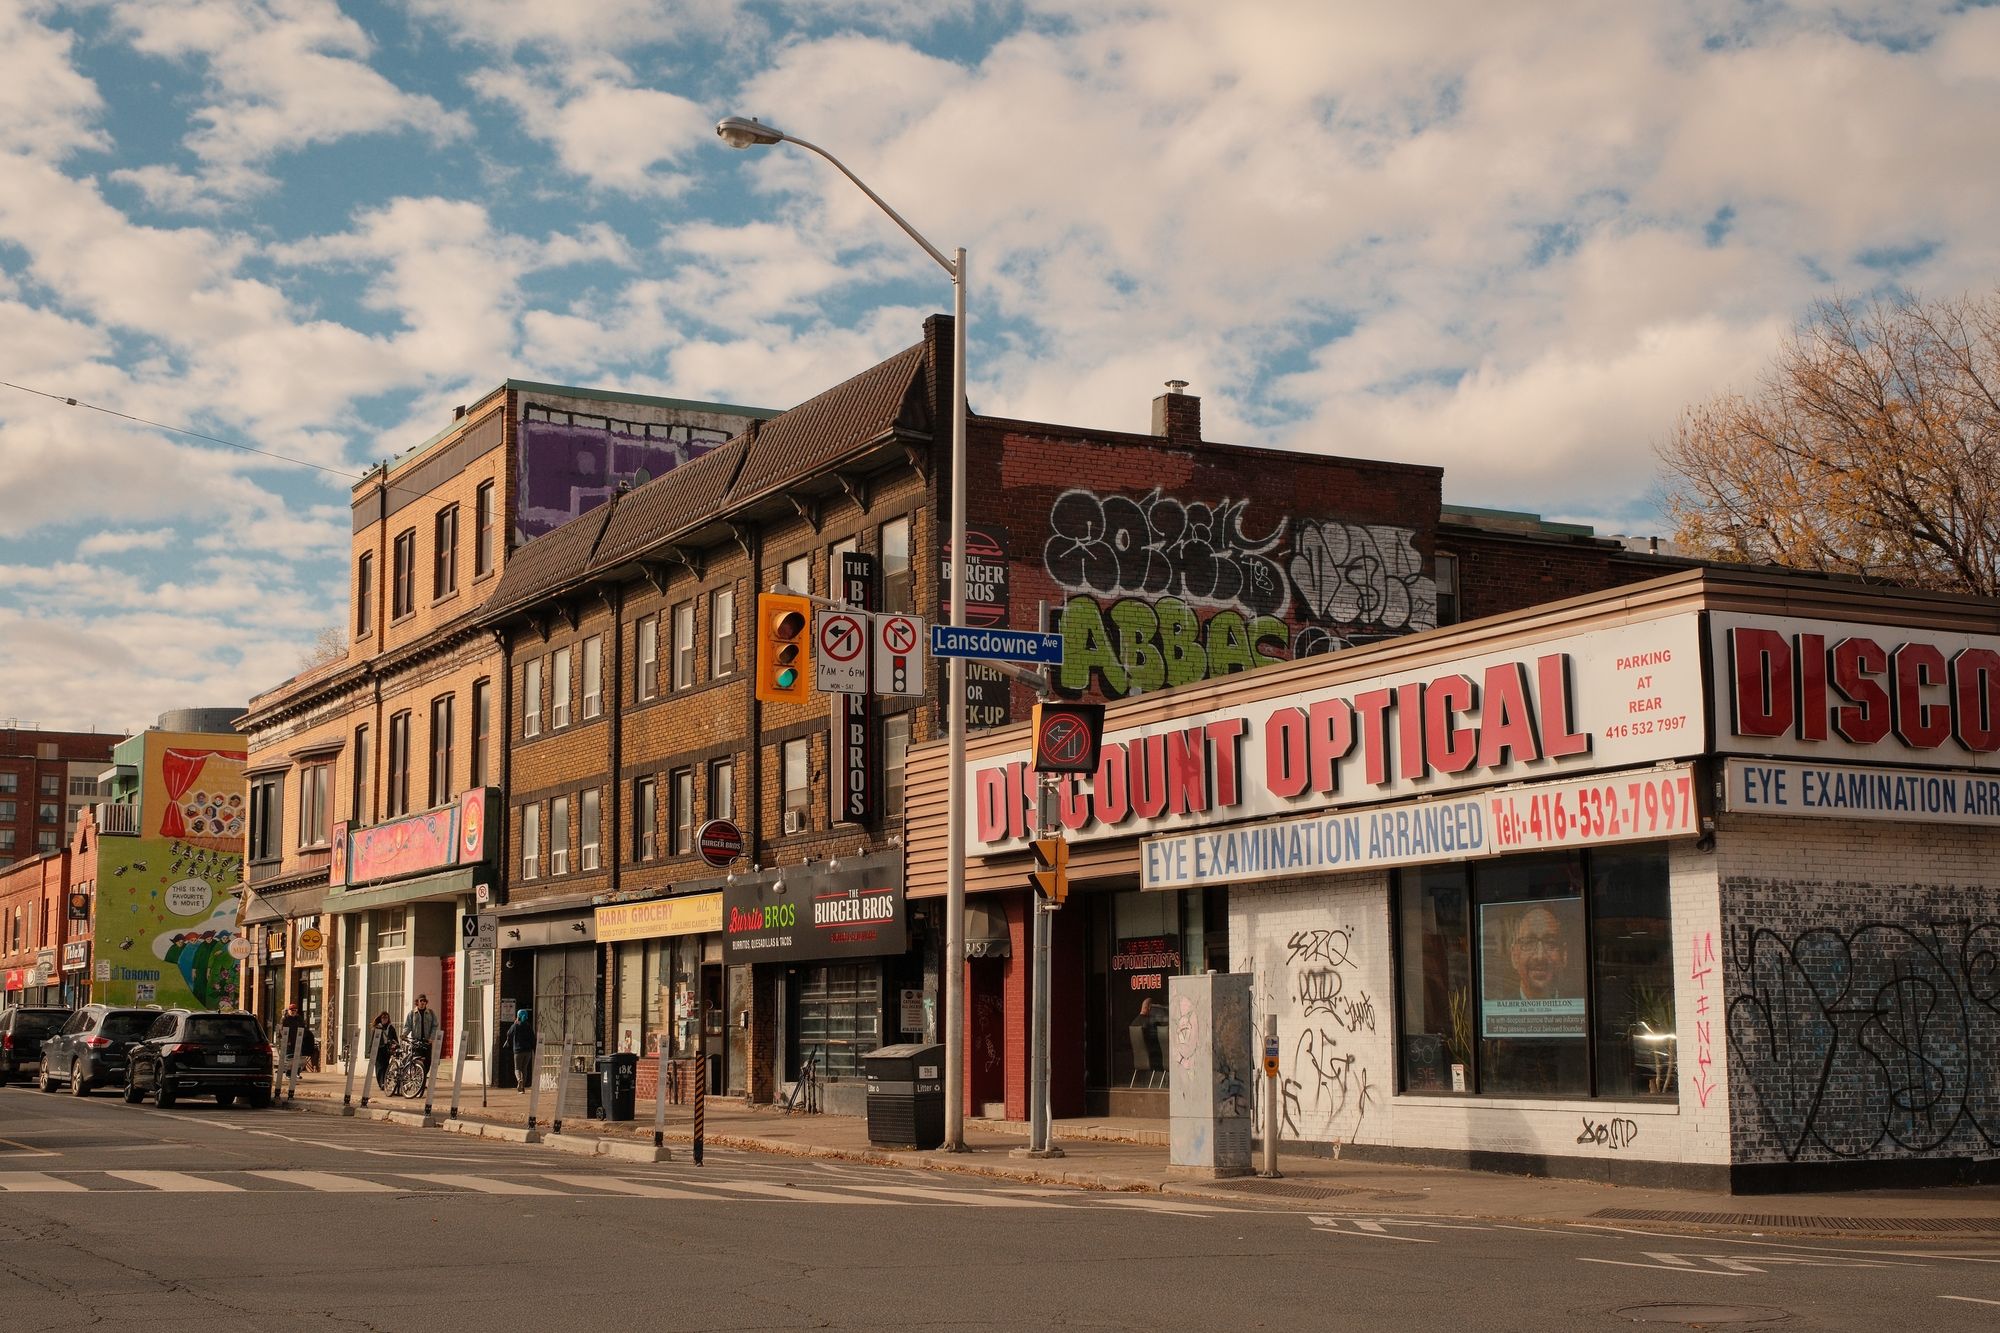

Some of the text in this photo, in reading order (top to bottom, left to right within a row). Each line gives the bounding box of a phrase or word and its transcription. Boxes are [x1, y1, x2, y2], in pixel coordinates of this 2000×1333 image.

[845, 561, 869, 576] THE
[967, 556, 980, 564] THE
[942, 562, 1004, 584] BRGER
[965, 583, 995, 602] ROS
[937, 629, 1058, 655] Lansdowne Ave
[1616, 650, 1671, 671] PARKING
[1636, 675, 1652, 690] AT
[967, 686, 983, 700] OR
[1629, 696, 1662, 713] REAR
[946, 705, 1004, 725] CK-UP
[1265, 652, 1592, 797] OPTICAL
[1605, 715, 1687, 739] 416 532 7997
[850, 724, 865, 815] BROS
[1744, 767, 1787, 805] EYE
[1802, 770, 1957, 813] EXAMINATION
[701, 839, 725, 848] BURGER
[1147, 801, 1483, 883] EYE EXAMINATION ARRANGED
[848, 889, 859, 898] THE
[600, 903, 674, 927] HARAR GROCERY
[729, 906, 763, 933] Burrito
[764, 903, 795, 929] BROS
[814, 895, 893, 924] BURGER BROS
[779, 936, 792, 946] TACOS
[1112, 952, 1181, 971] OPTOMETRIST'S
[121, 967, 160, 981] TORONTO
[1130, 974, 1162, 990] OFFICE
[917, 1084, 932, 1093] Litter
